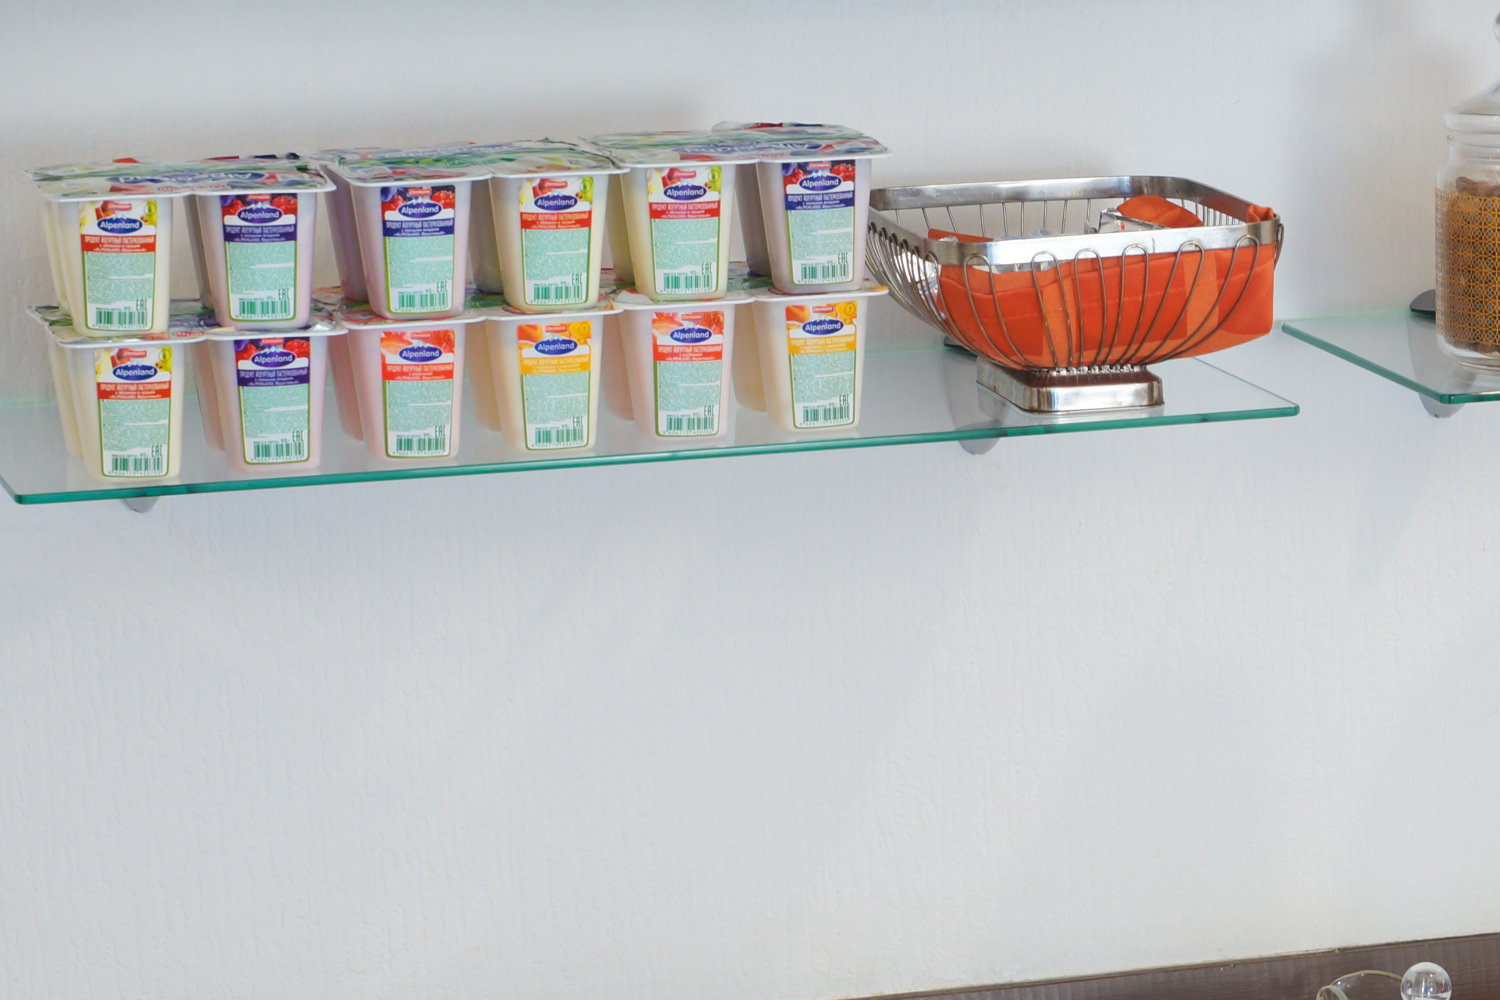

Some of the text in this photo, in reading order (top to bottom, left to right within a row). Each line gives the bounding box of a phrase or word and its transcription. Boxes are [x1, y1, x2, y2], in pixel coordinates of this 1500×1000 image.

[802, 178, 839, 188] Alpenland
[666, 188, 704, 197] Alpenland
[538, 198, 575, 207] Alpenland
[240, 210, 280, 220] Alpenland
[401, 205, 439, 215] Alpenland
[100, 221, 140, 230] Alpenland
[805, 322, 841, 332] Alpenland
[672, 329, 710, 339] Alpenland
[537, 342, 575, 351] Alpenland
[253, 354, 293, 364] Alpenland
[401, 349, 440, 359] Alpenland
[115, 368, 155, 377] Alpenland
